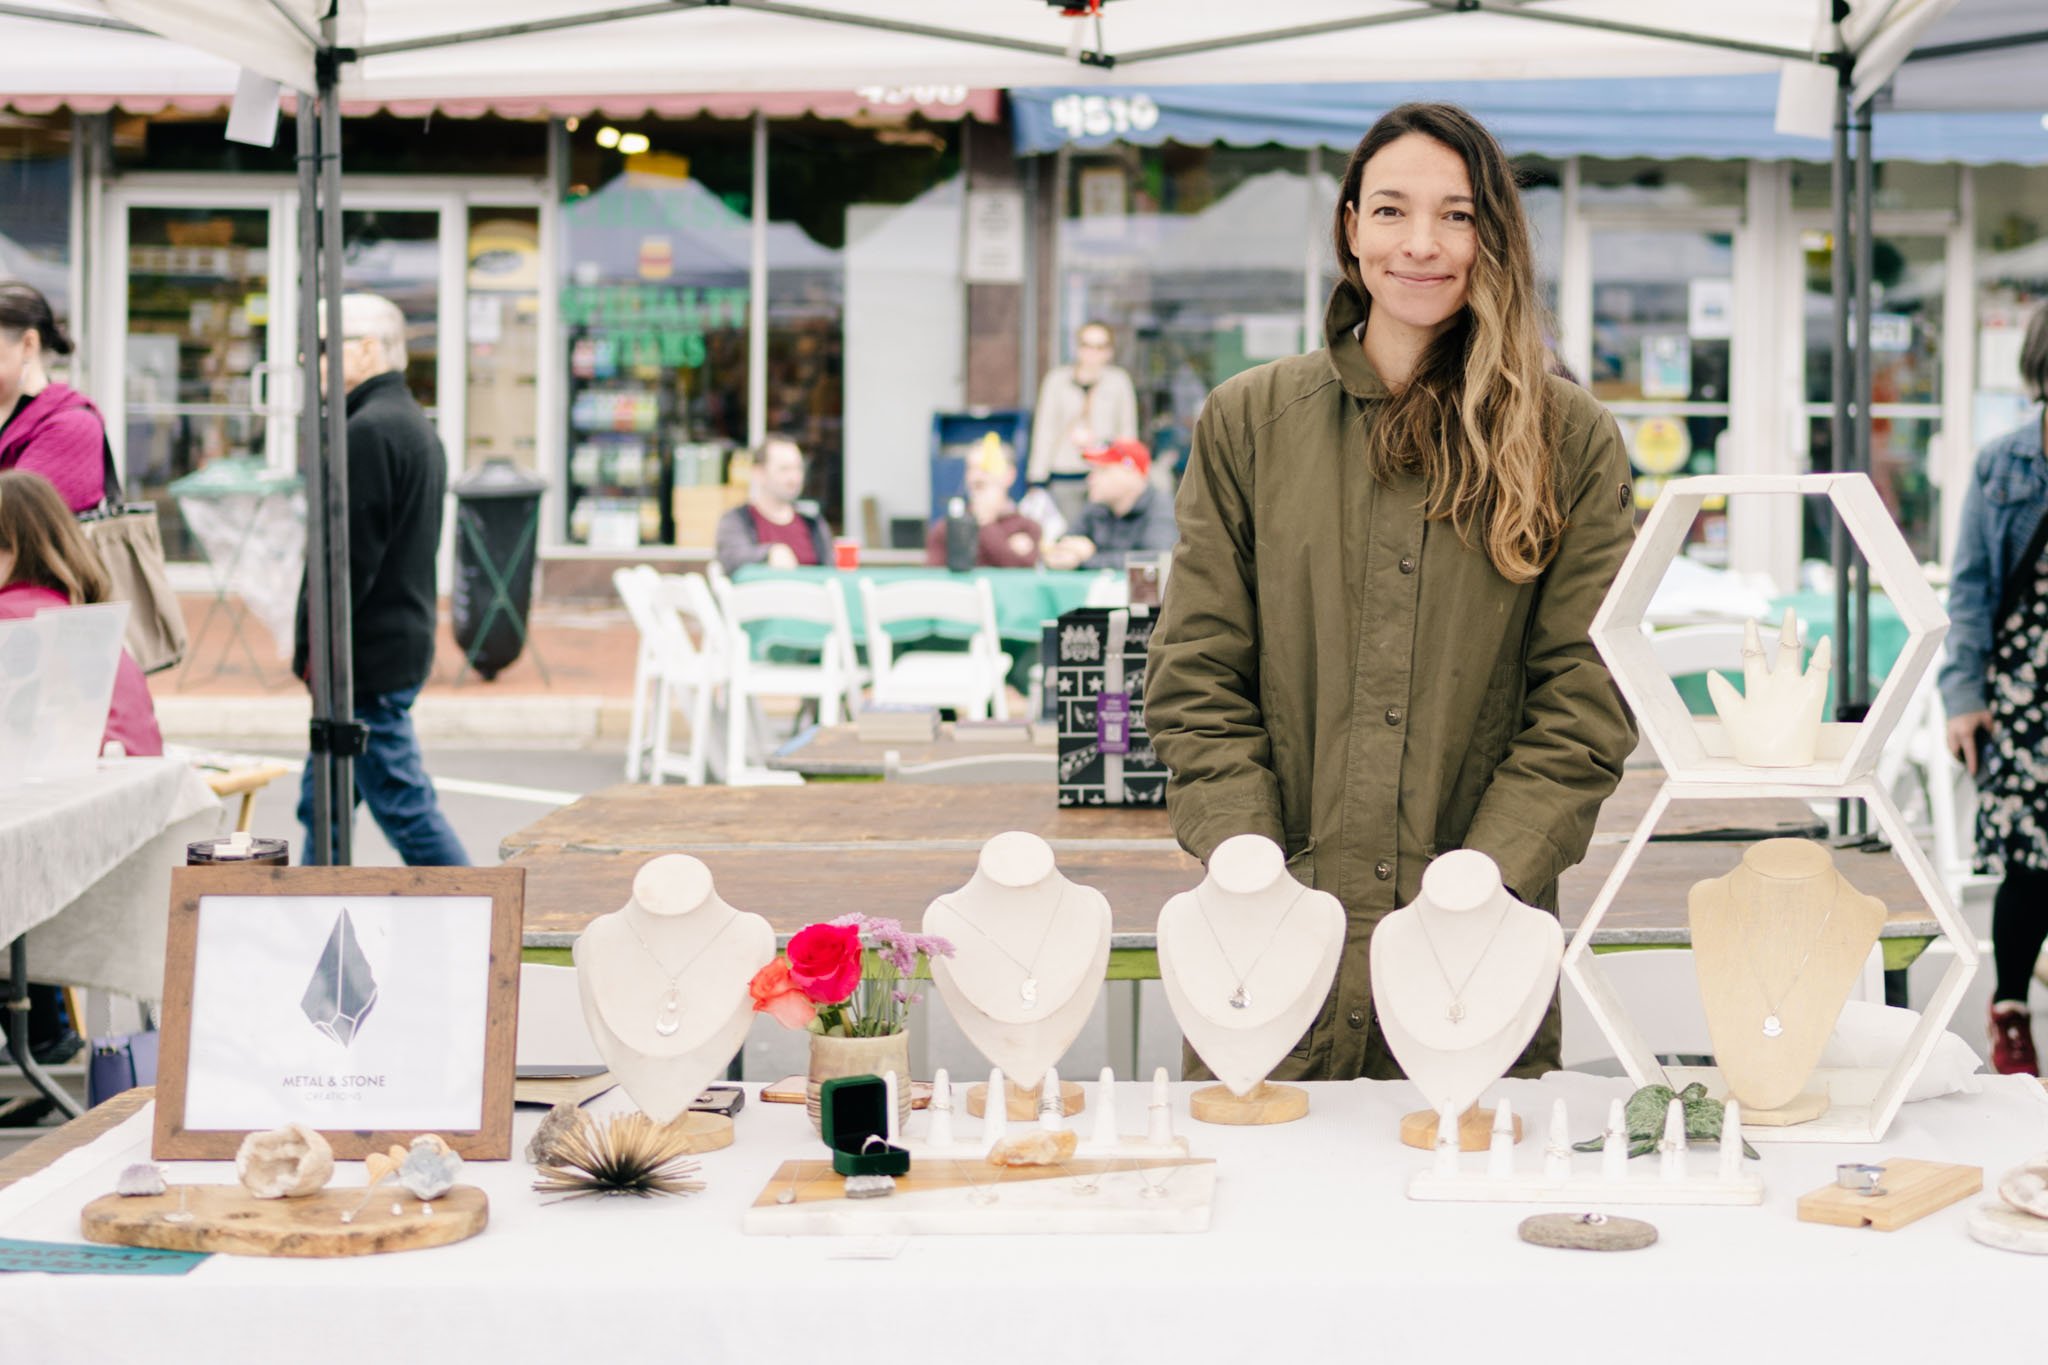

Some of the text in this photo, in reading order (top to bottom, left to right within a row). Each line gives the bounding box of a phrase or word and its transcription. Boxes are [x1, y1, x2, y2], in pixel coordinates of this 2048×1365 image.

[282, 1075, 387, 1087] METAL & STONE
